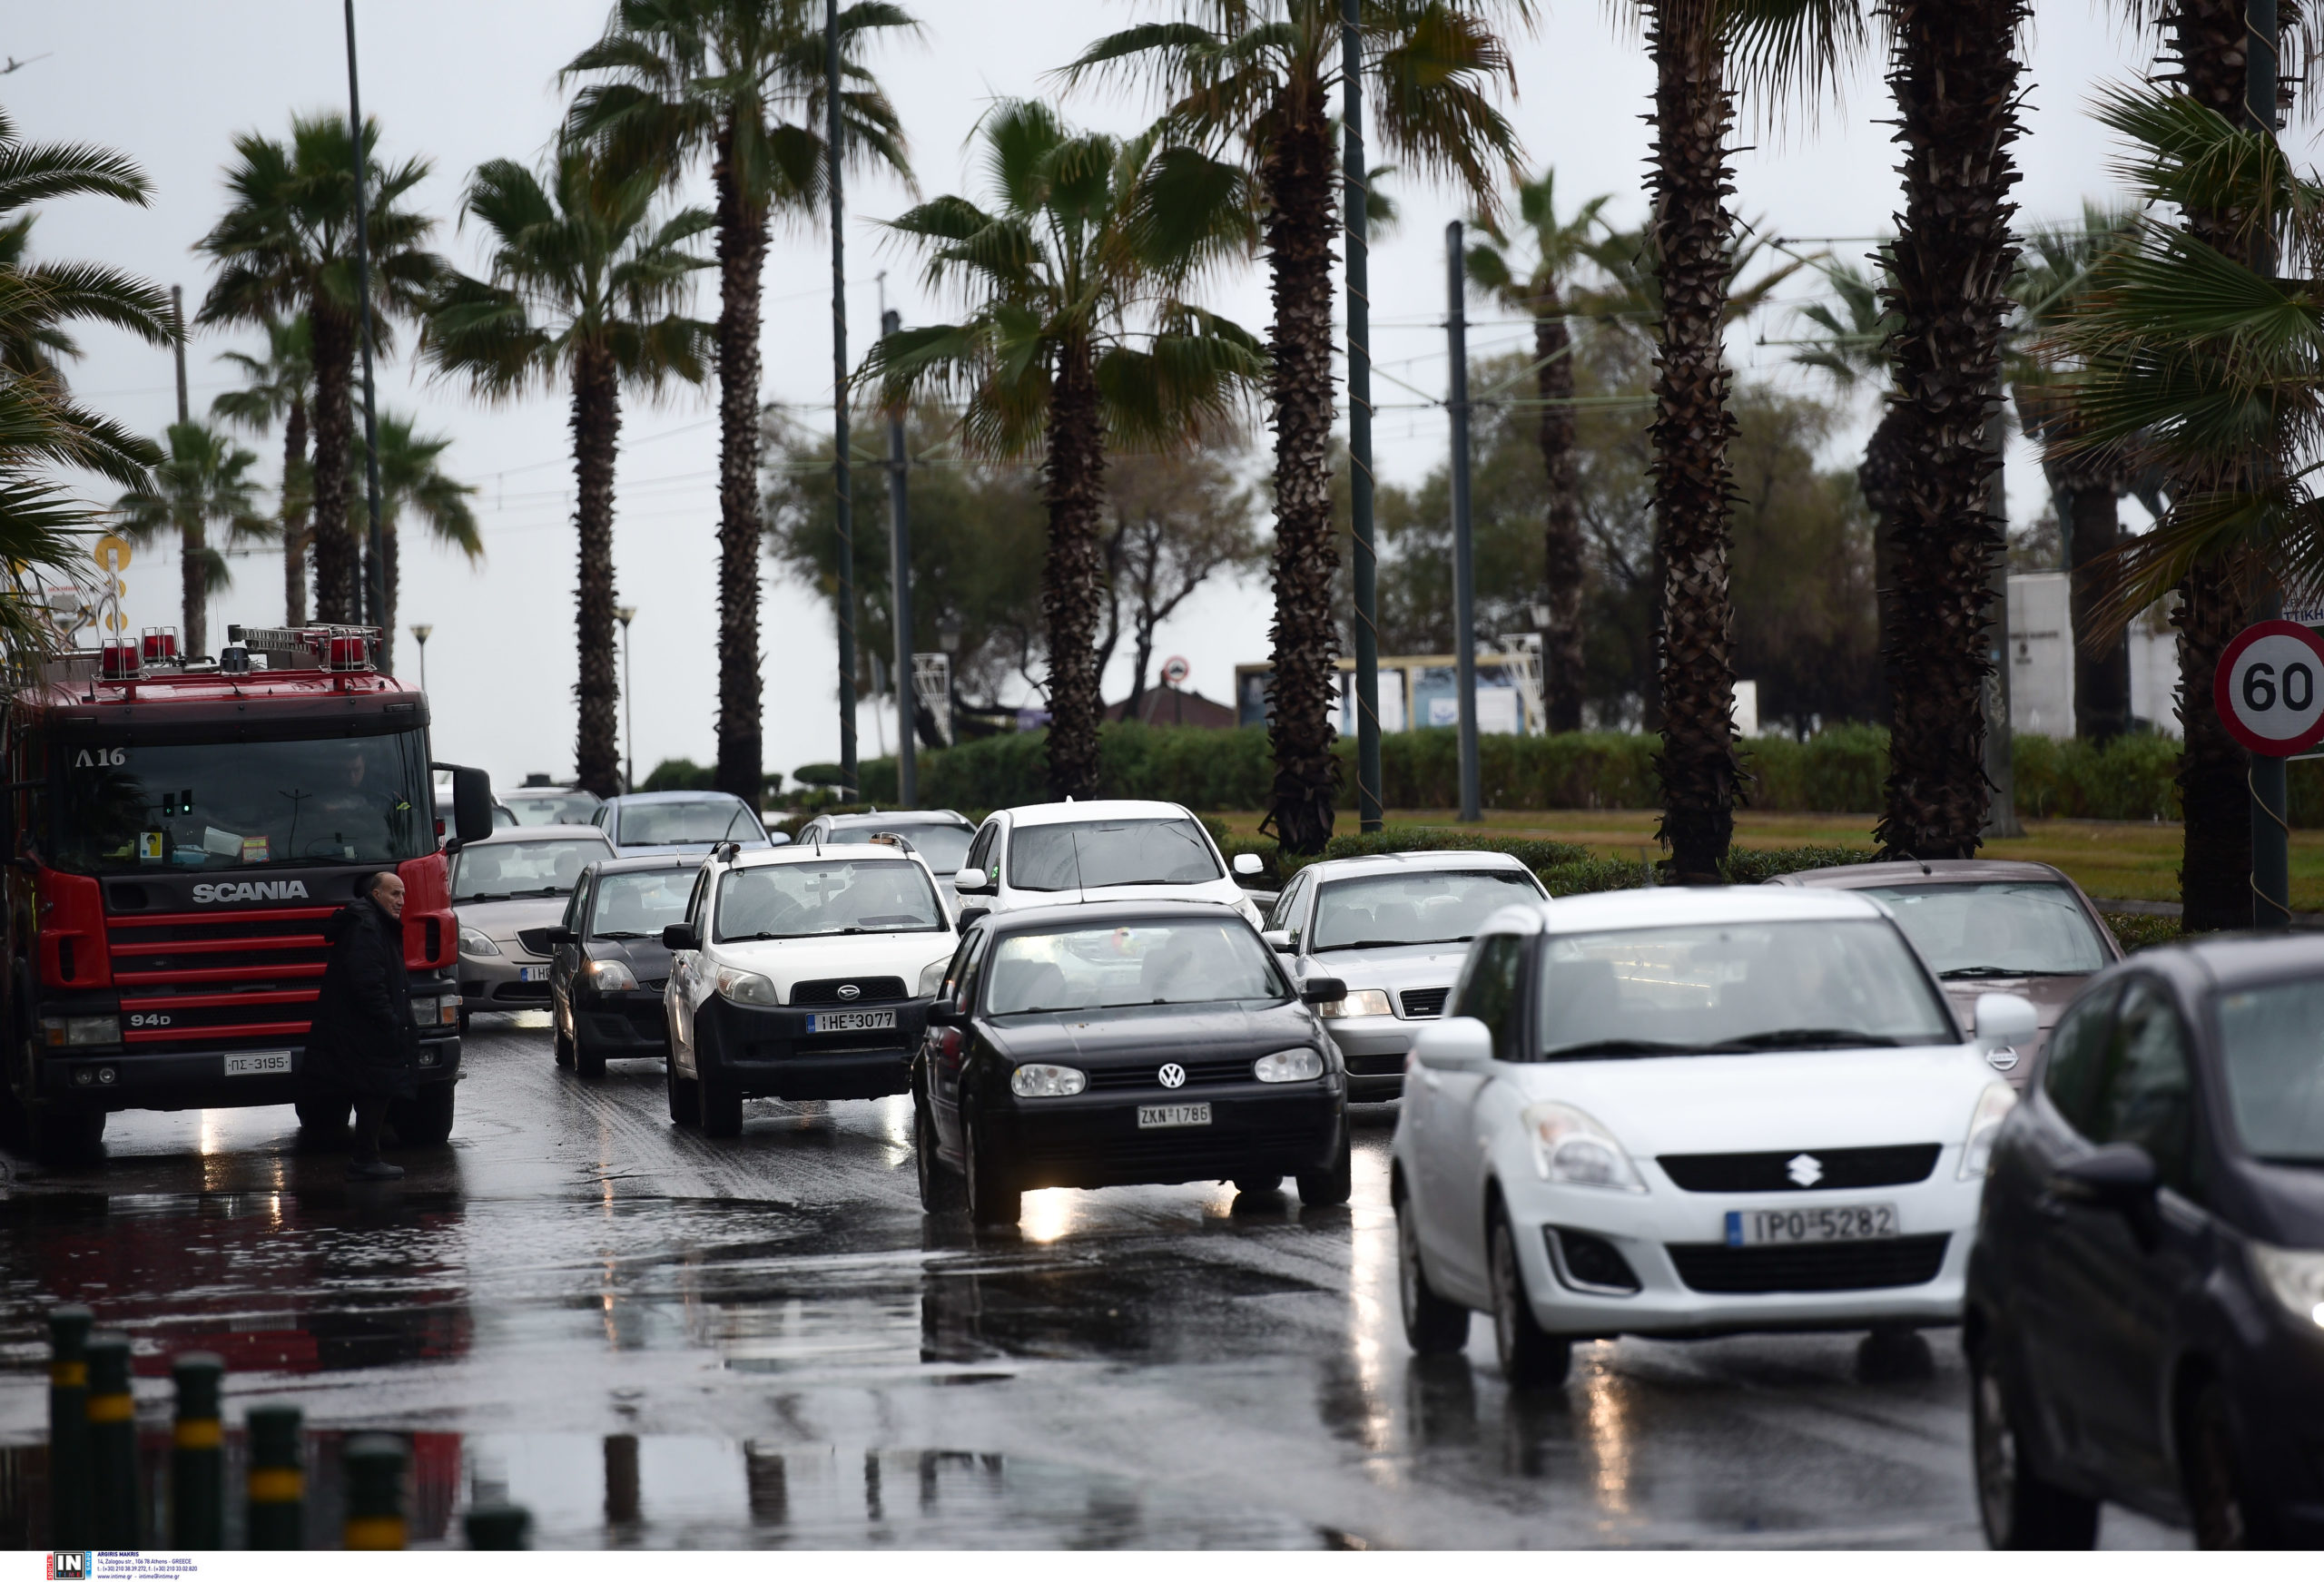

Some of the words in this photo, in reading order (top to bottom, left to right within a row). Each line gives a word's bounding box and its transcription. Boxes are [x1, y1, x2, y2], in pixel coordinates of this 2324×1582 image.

[2242, 663, 2313, 712] 60
[98, 747, 125, 766] 16
[192, 879, 309, 903] SCANIA
[131, 1014, 171, 1027] 94D
